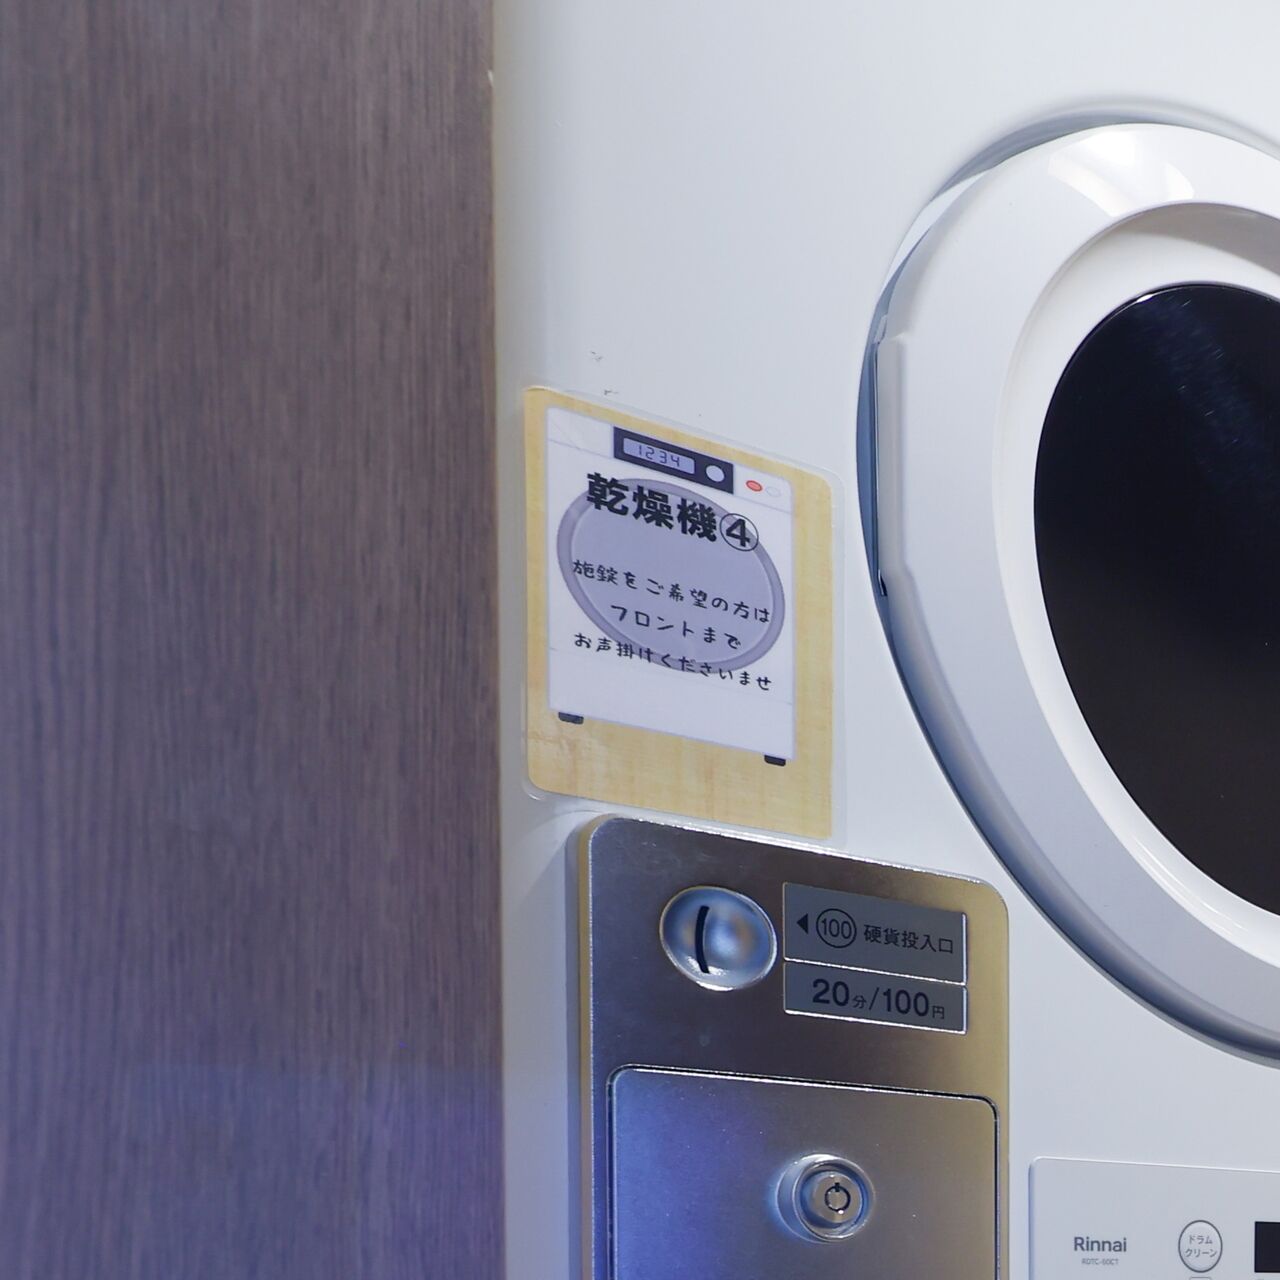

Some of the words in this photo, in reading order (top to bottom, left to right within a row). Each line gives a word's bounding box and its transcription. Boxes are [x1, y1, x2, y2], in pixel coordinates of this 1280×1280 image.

[572, 560, 771, 624] 施錠をご希望の方は
[611, 605, 742, 651] フロントまで
[573, 633, 772, 692] お声掛けくださいませ
[864, 923, 954, 954] 硬貨投入口
[1074, 1236, 1127, 1253] Rinnai
[1184, 1248, 1218, 1259] クリーン
[1188, 1235, 1214, 1245] ドラム
